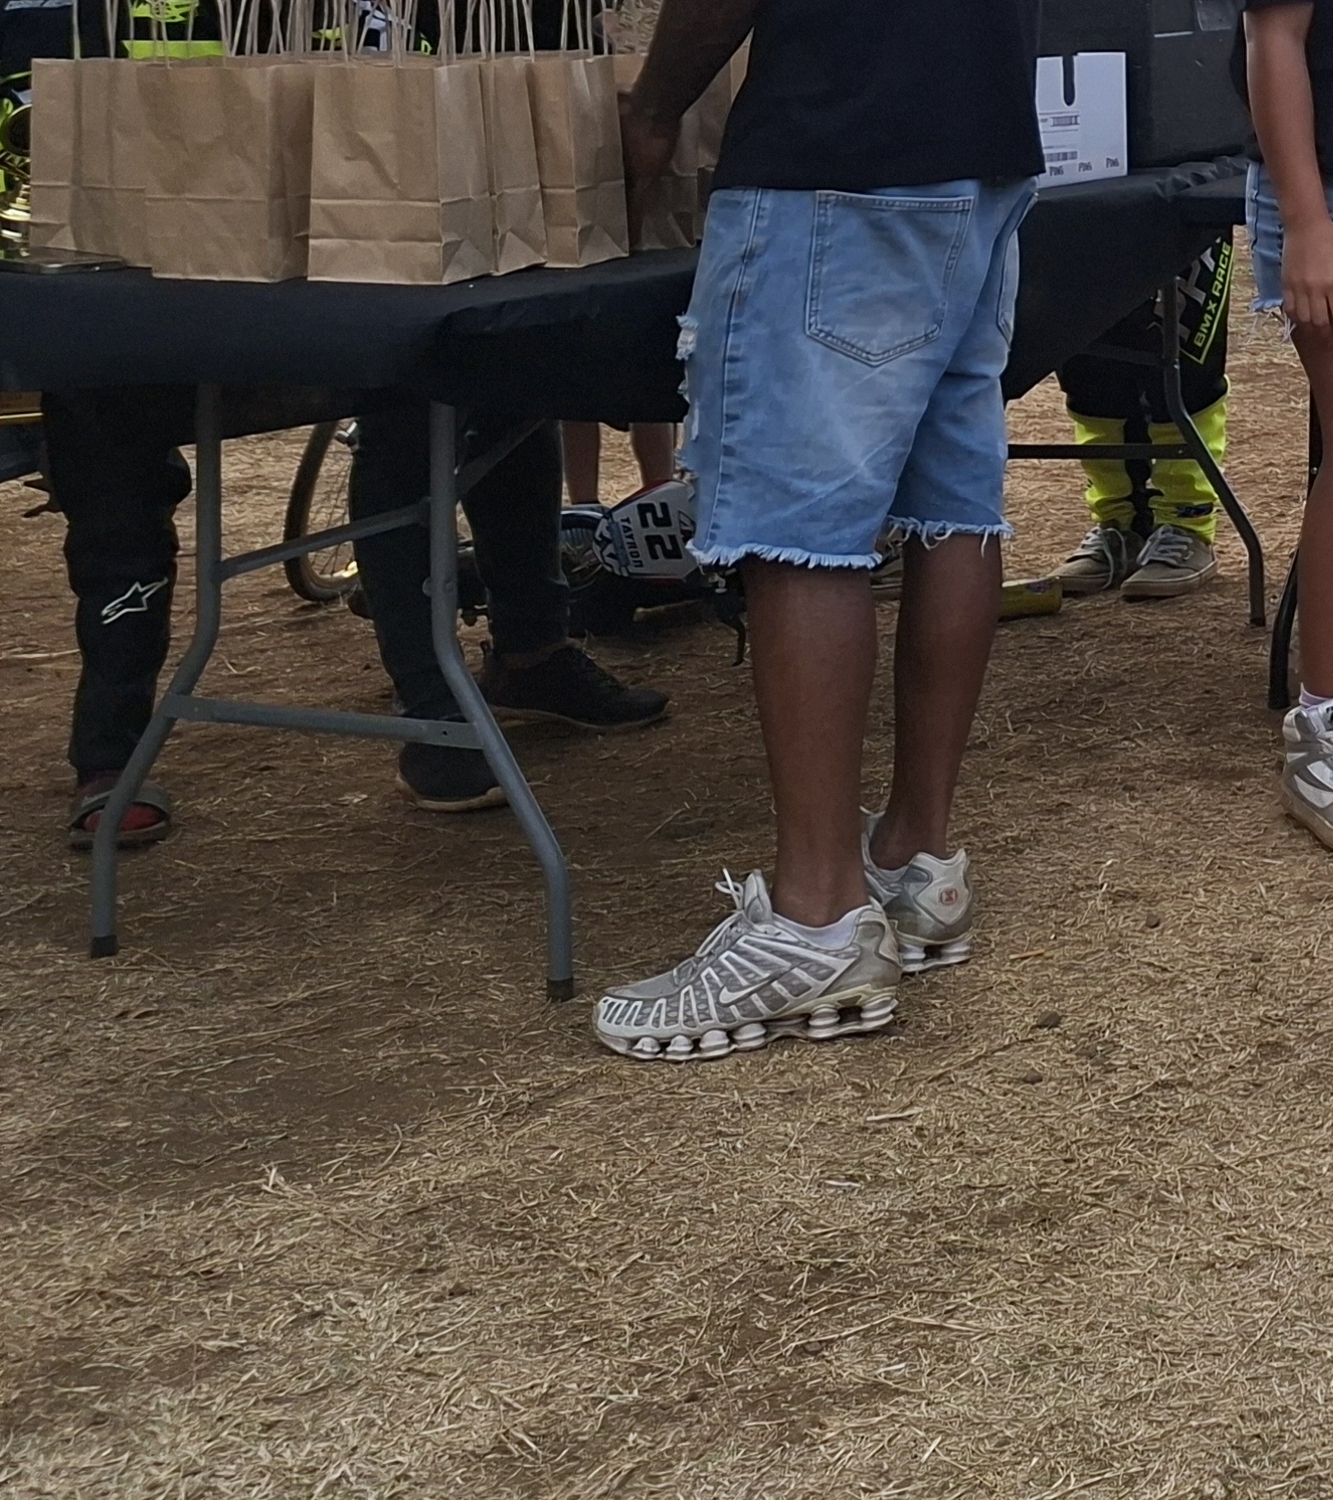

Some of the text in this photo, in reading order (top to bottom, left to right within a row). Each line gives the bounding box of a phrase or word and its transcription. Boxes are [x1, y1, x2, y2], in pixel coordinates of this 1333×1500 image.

[1192, 241, 1232, 348] BMX RACE
[636, 501, 683, 560] 22
